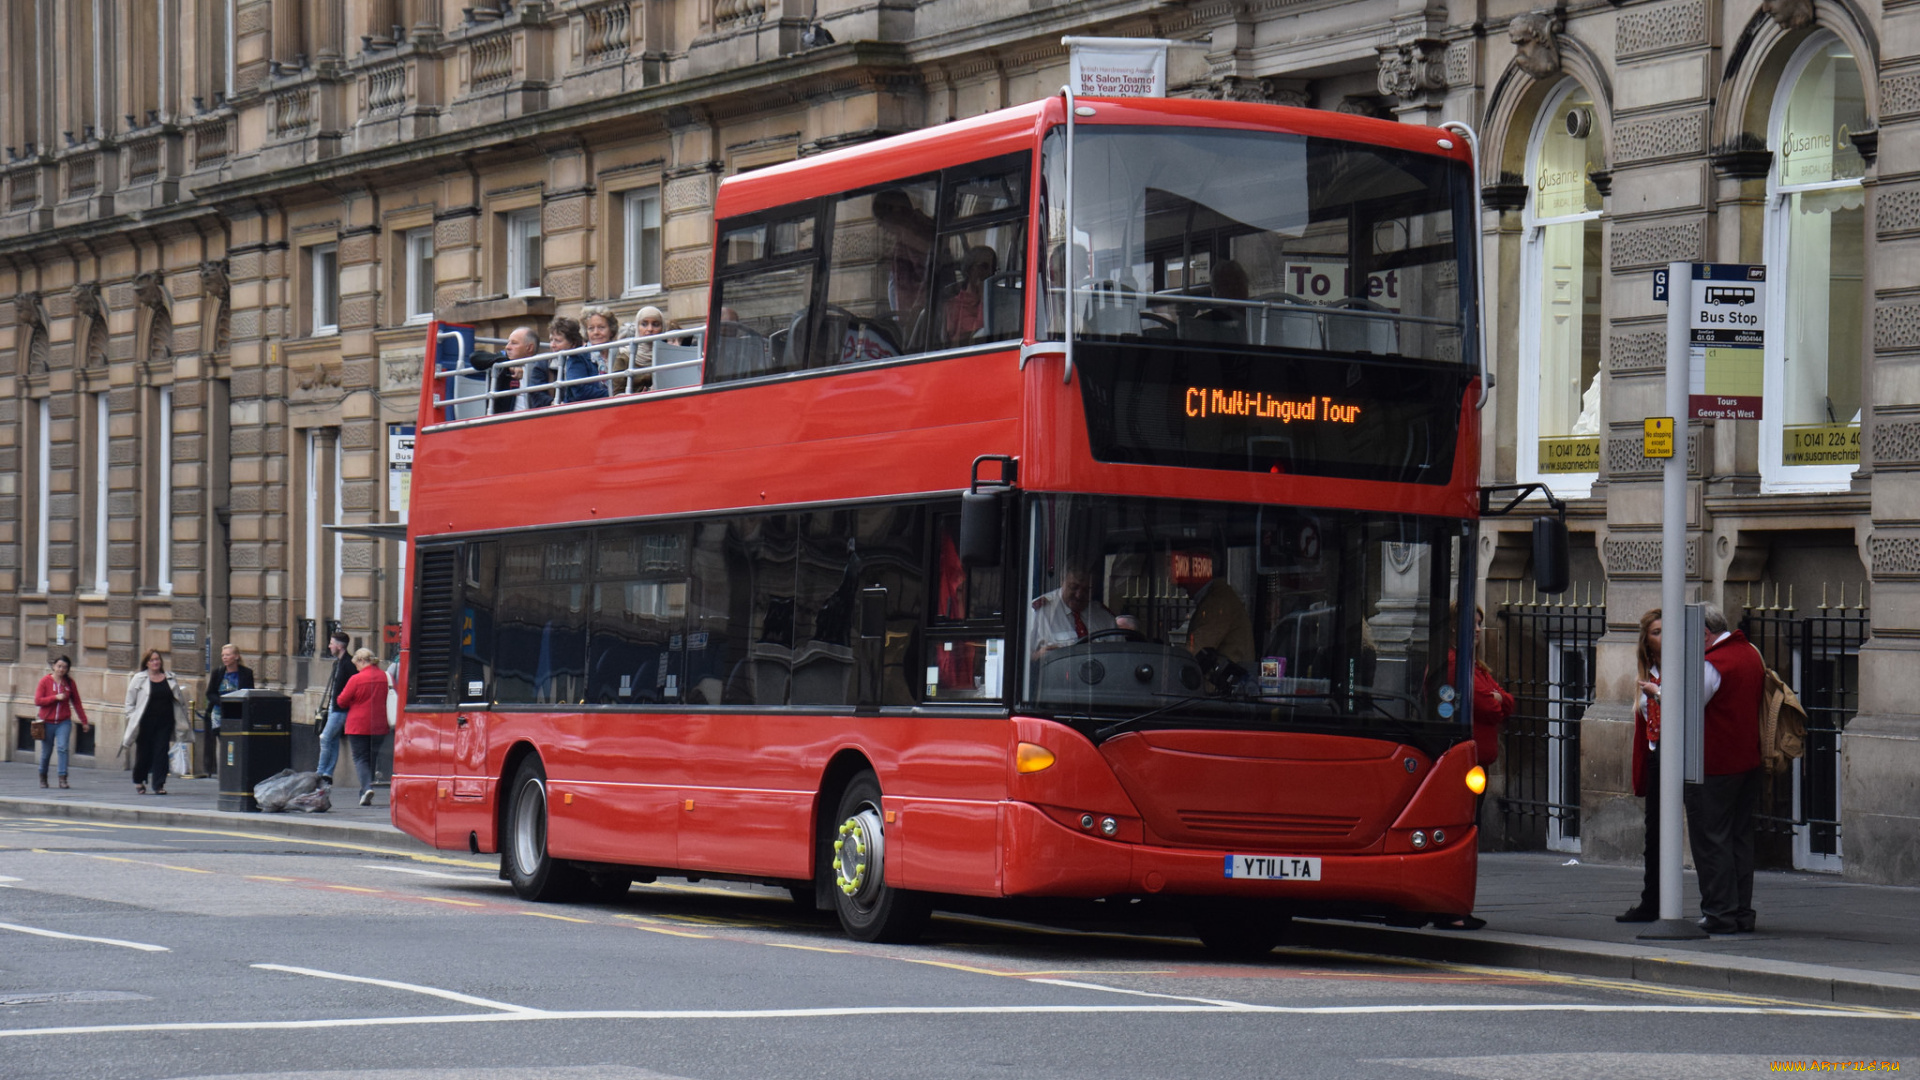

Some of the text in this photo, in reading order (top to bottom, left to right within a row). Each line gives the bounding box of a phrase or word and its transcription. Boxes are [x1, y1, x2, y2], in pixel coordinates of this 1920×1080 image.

[1081, 74, 1155, 84] UK Salon Team of
[1081, 83, 1152, 94] the Year 2012/13
[1783, 132, 1831, 157] Susanne
[1538, 168, 1579, 191] Susanne
[1290, 266, 1331, 296] To
[1656, 272, 1666, 285] G
[1656, 285, 1665, 298] P
[1700, 311, 1758, 326] Bus Stop
[1186, 387, 1361, 424] C1 Multi-Lingual Tour
[1717, 397, 1737, 406] Tours
[1698, 409, 1755, 419] George Sq West
[1804, 433, 1824, 447] 0141
[1828, 432, 1846, 446] 226
[395, 452, 411, 460] Bus
[1556, 444, 1573, 457] 0141
[1576, 443, 1591, 457] 226
